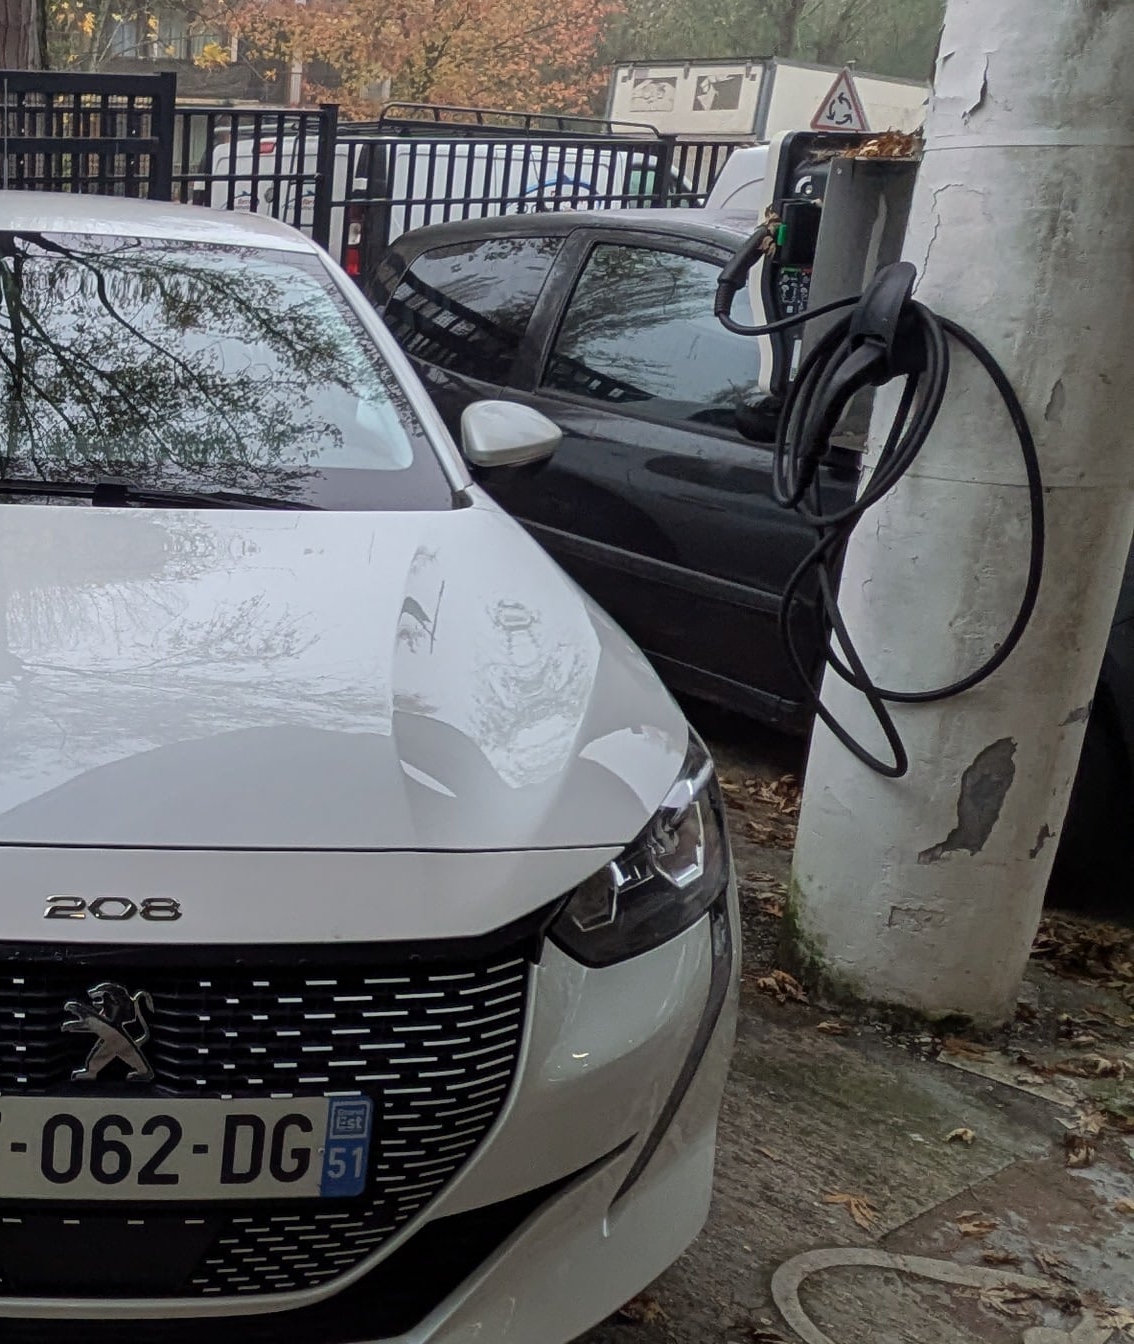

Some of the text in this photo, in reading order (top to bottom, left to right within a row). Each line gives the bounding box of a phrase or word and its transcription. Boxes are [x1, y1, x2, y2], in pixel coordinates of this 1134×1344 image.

[43, 894, 182, 921] 208
[336, 1116, 364, 1130] Est
[327, 1147, 364, 1179] 51
